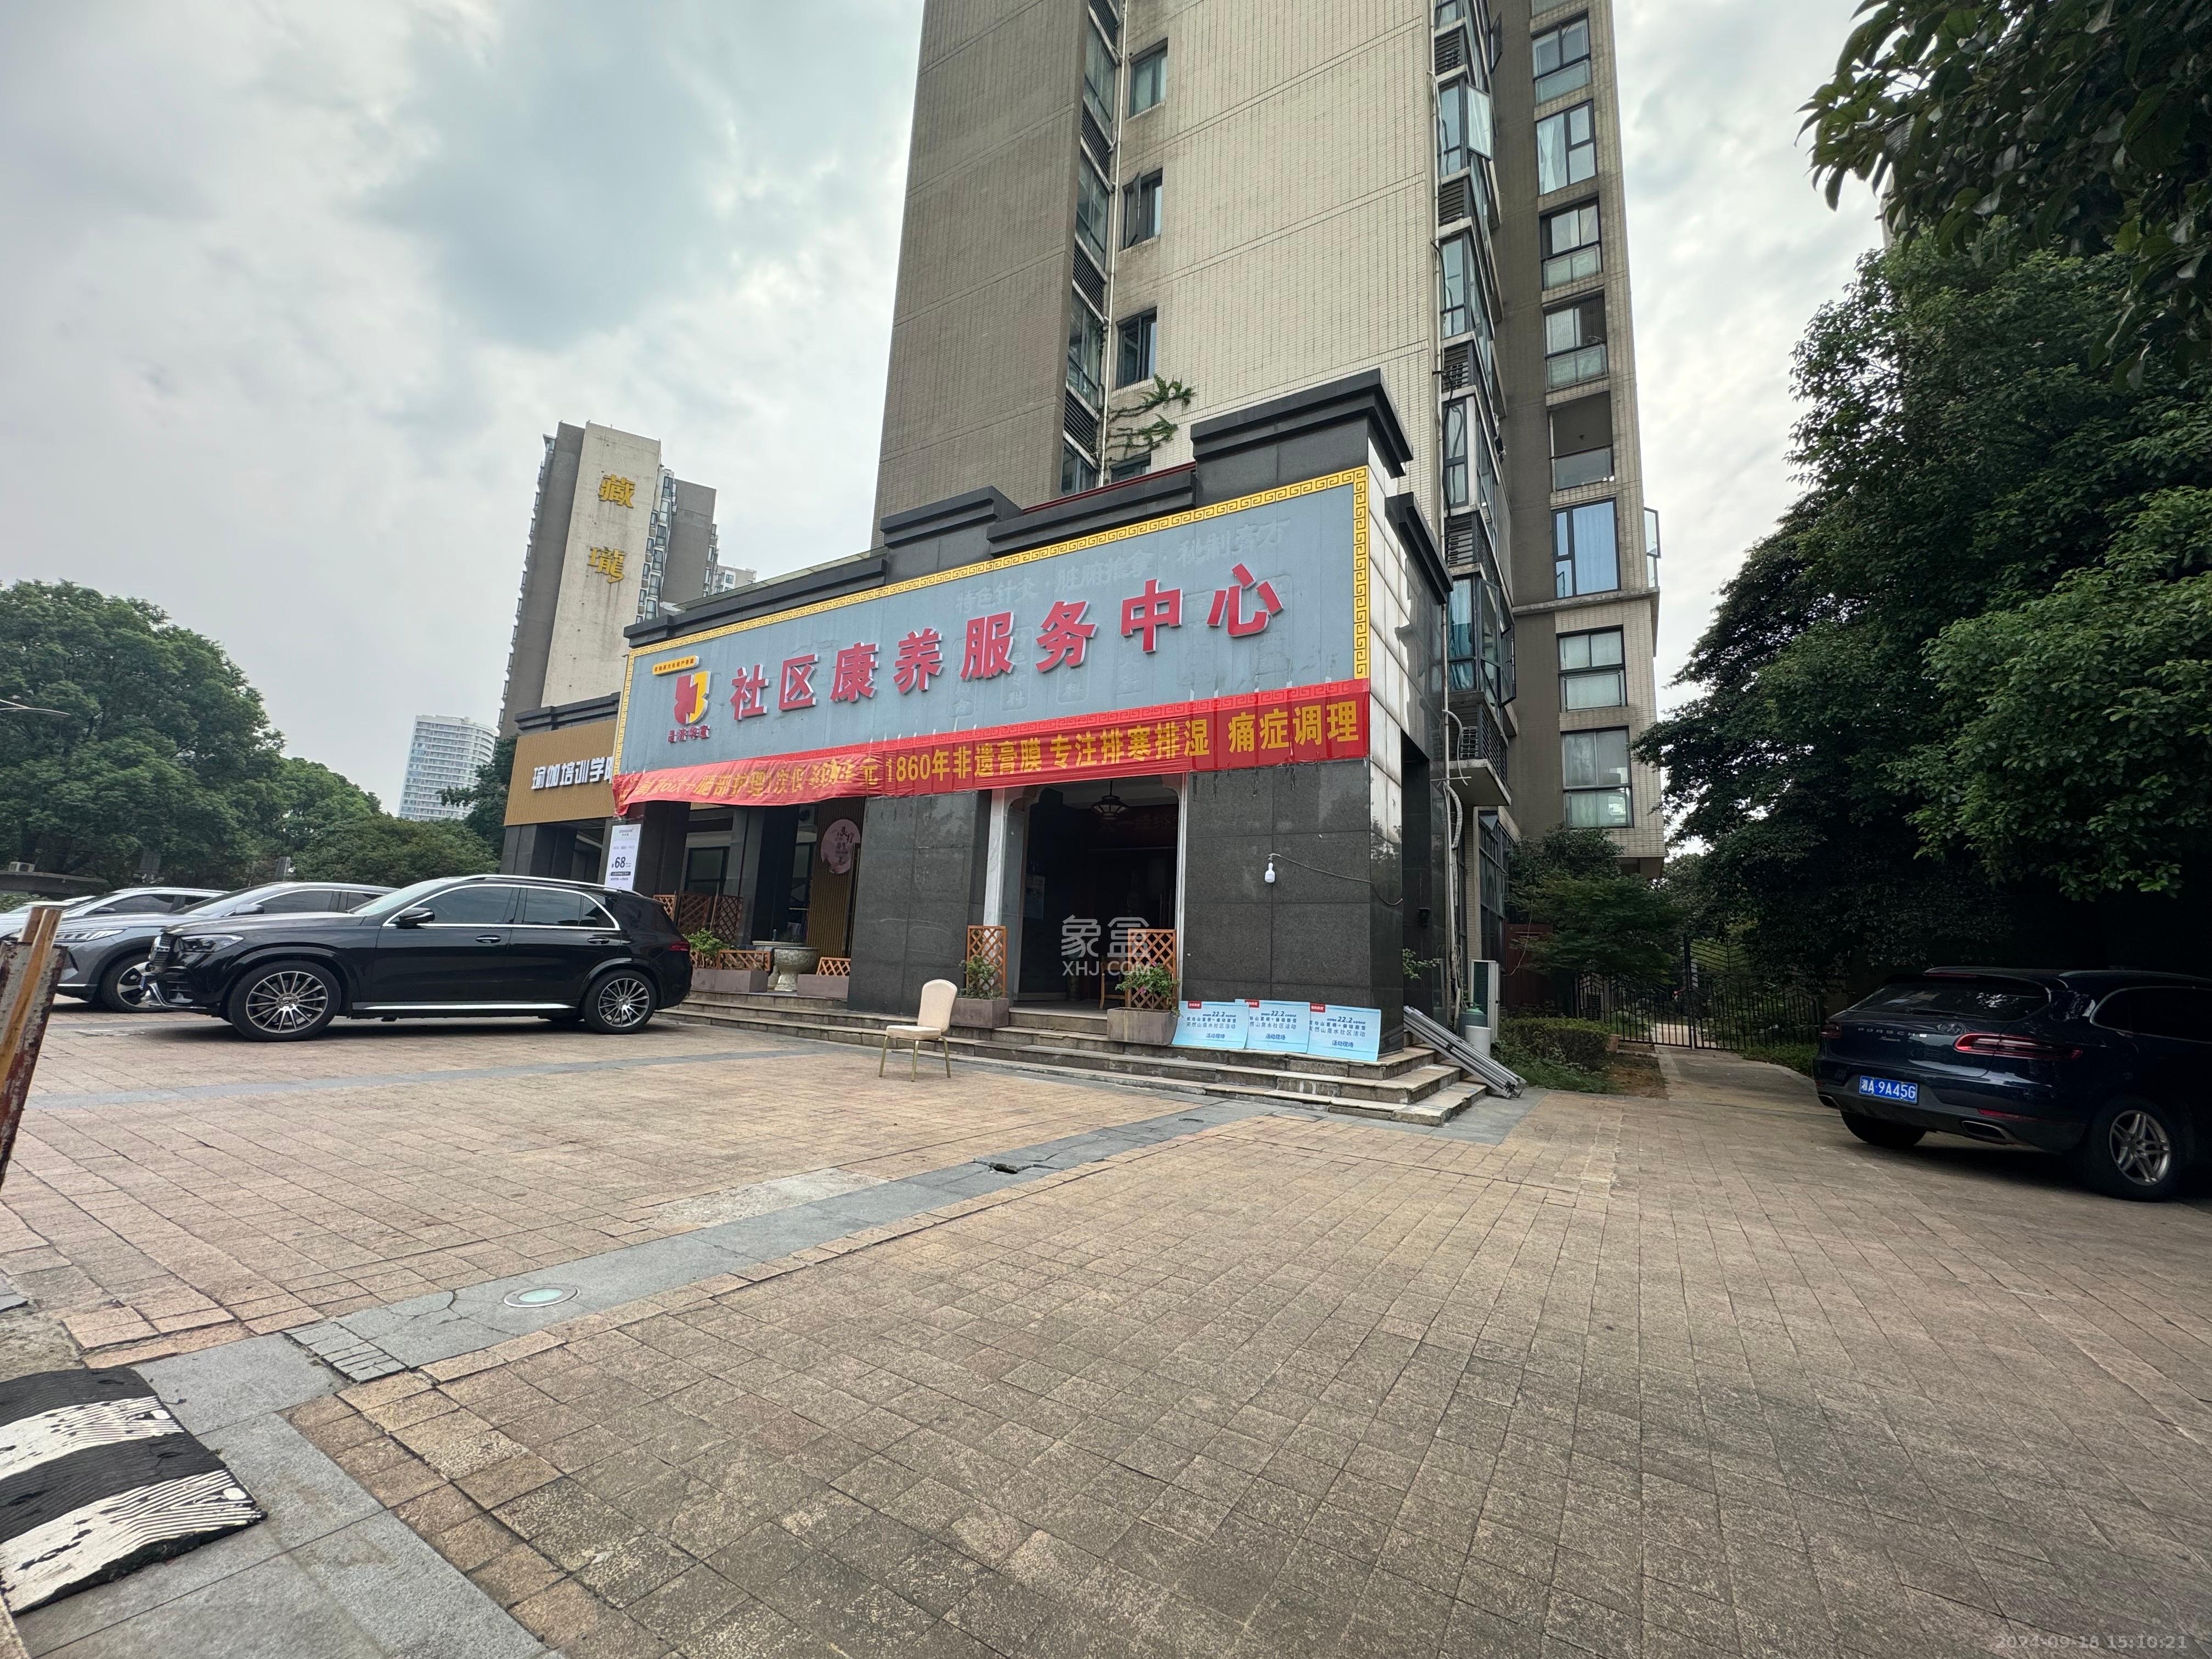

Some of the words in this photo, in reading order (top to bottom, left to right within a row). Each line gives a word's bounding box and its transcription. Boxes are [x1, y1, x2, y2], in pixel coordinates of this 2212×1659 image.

[730, 563, 1284, 721] 社区康养服务中心
[1049, 719, 1210, 769] 专注排寒排湿
[1228, 701, 1358, 753] 痛症调理
